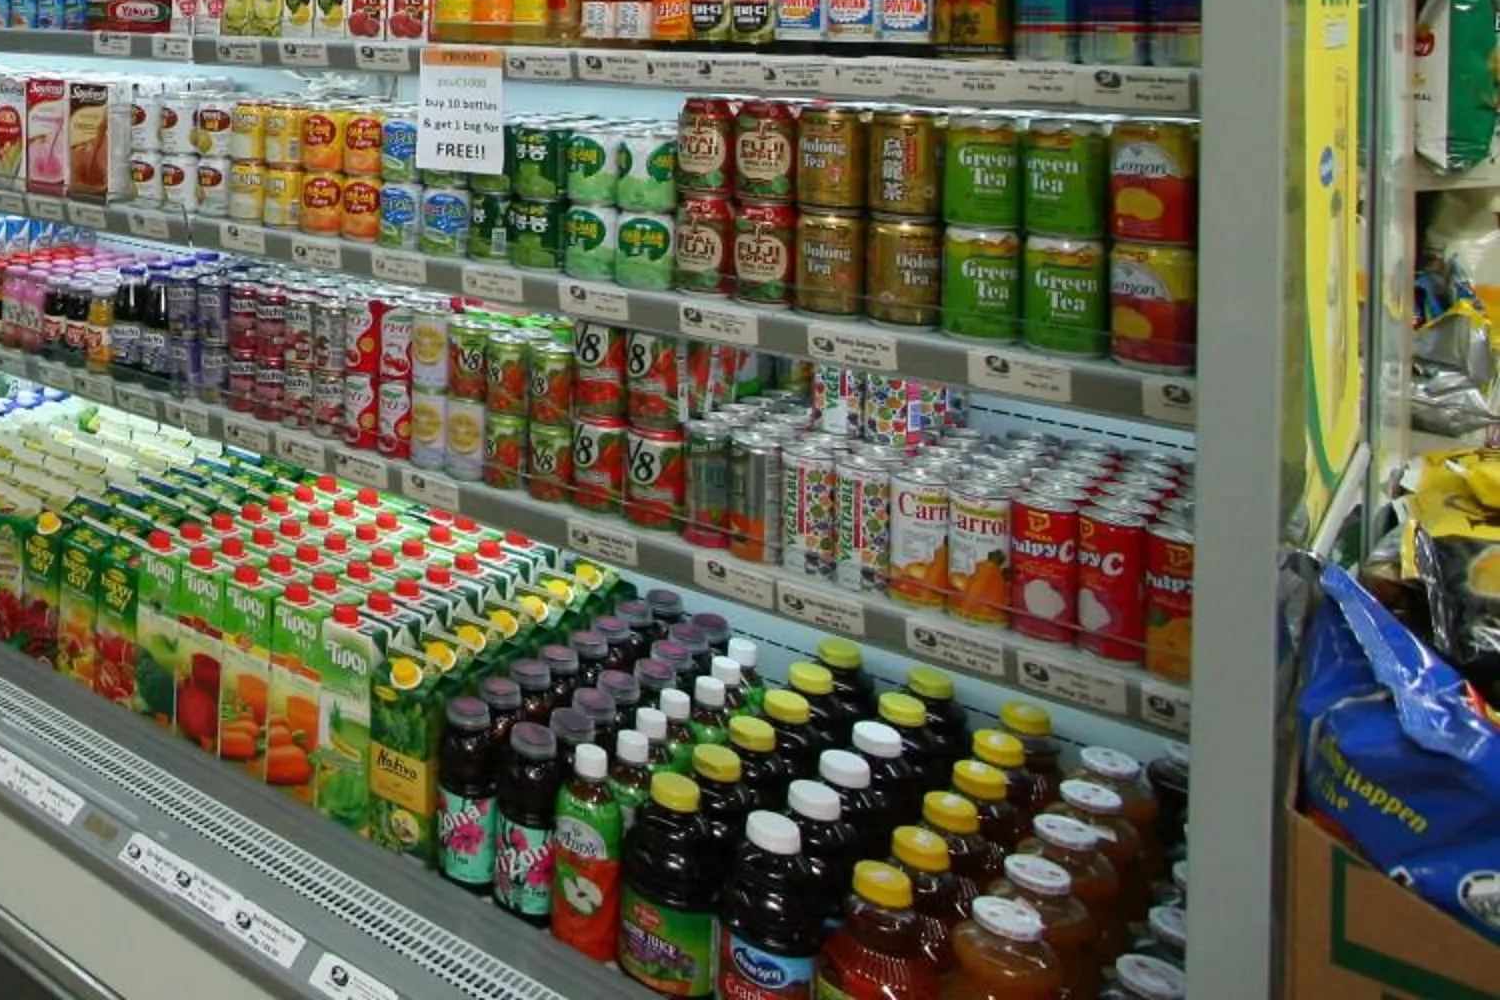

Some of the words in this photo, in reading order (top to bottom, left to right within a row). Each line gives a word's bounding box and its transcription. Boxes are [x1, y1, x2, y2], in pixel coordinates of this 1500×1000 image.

[121, 7, 156, 19] Yakult
[425, 99, 445, 110] buy
[450, 99, 461, 108] 10
[463, 100, 498, 111] bottles
[423, 118, 432, 128] &
[434, 121, 453, 131] get
[483, 124, 500, 133] for
[436, 142, 486, 160] FREE!!
[958, 148, 1017, 168] Green
[971, 168, 1008, 188] Tea
[1030, 173, 1065, 194] Tea
[807, 258, 832, 276] Tea
[975, 281, 1010, 300] Tea
[1035, 268, 1099, 292] Green
[1046, 290, 1086, 313] Tea
[574, 321, 602, 364] V8
[461, 351, 482, 371] V8
[627, 440, 655, 481] V8
[898, 491, 948, 523] Carr
[184, 569, 219, 601] Tipco
[227, 586, 266, 620] Tipco
[275, 604, 317, 640] Tipco
[325, 638, 367, 675] Tipco
[1344, 766, 1428, 834] Happen
[647, 931, 677, 957] JUICE
